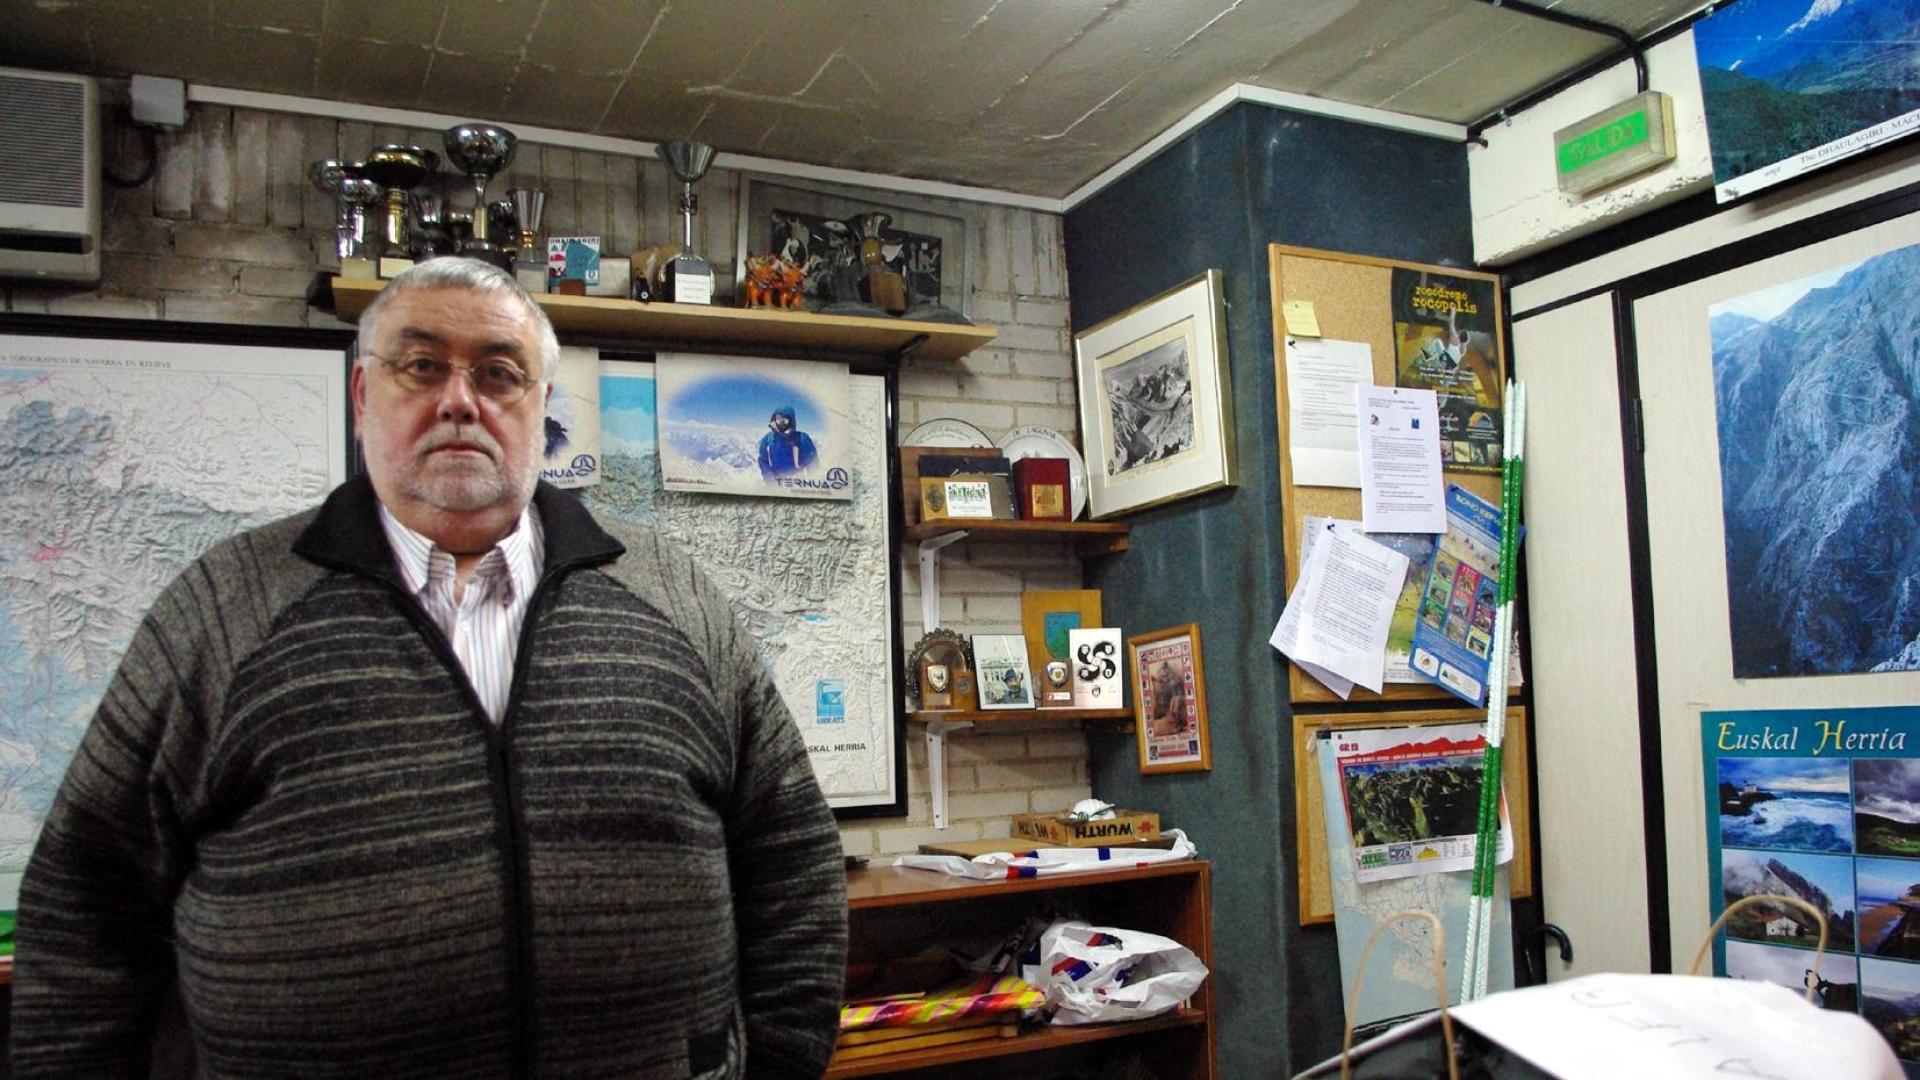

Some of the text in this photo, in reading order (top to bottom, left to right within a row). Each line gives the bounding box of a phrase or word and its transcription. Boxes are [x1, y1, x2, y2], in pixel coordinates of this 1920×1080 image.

[543, 469, 575, 478] NUA
[775, 475, 830, 489] TERNUA
[1717, 720, 1907, 756] Euskal Herria
[808, 742, 867, 753] SKAL HERRIA
